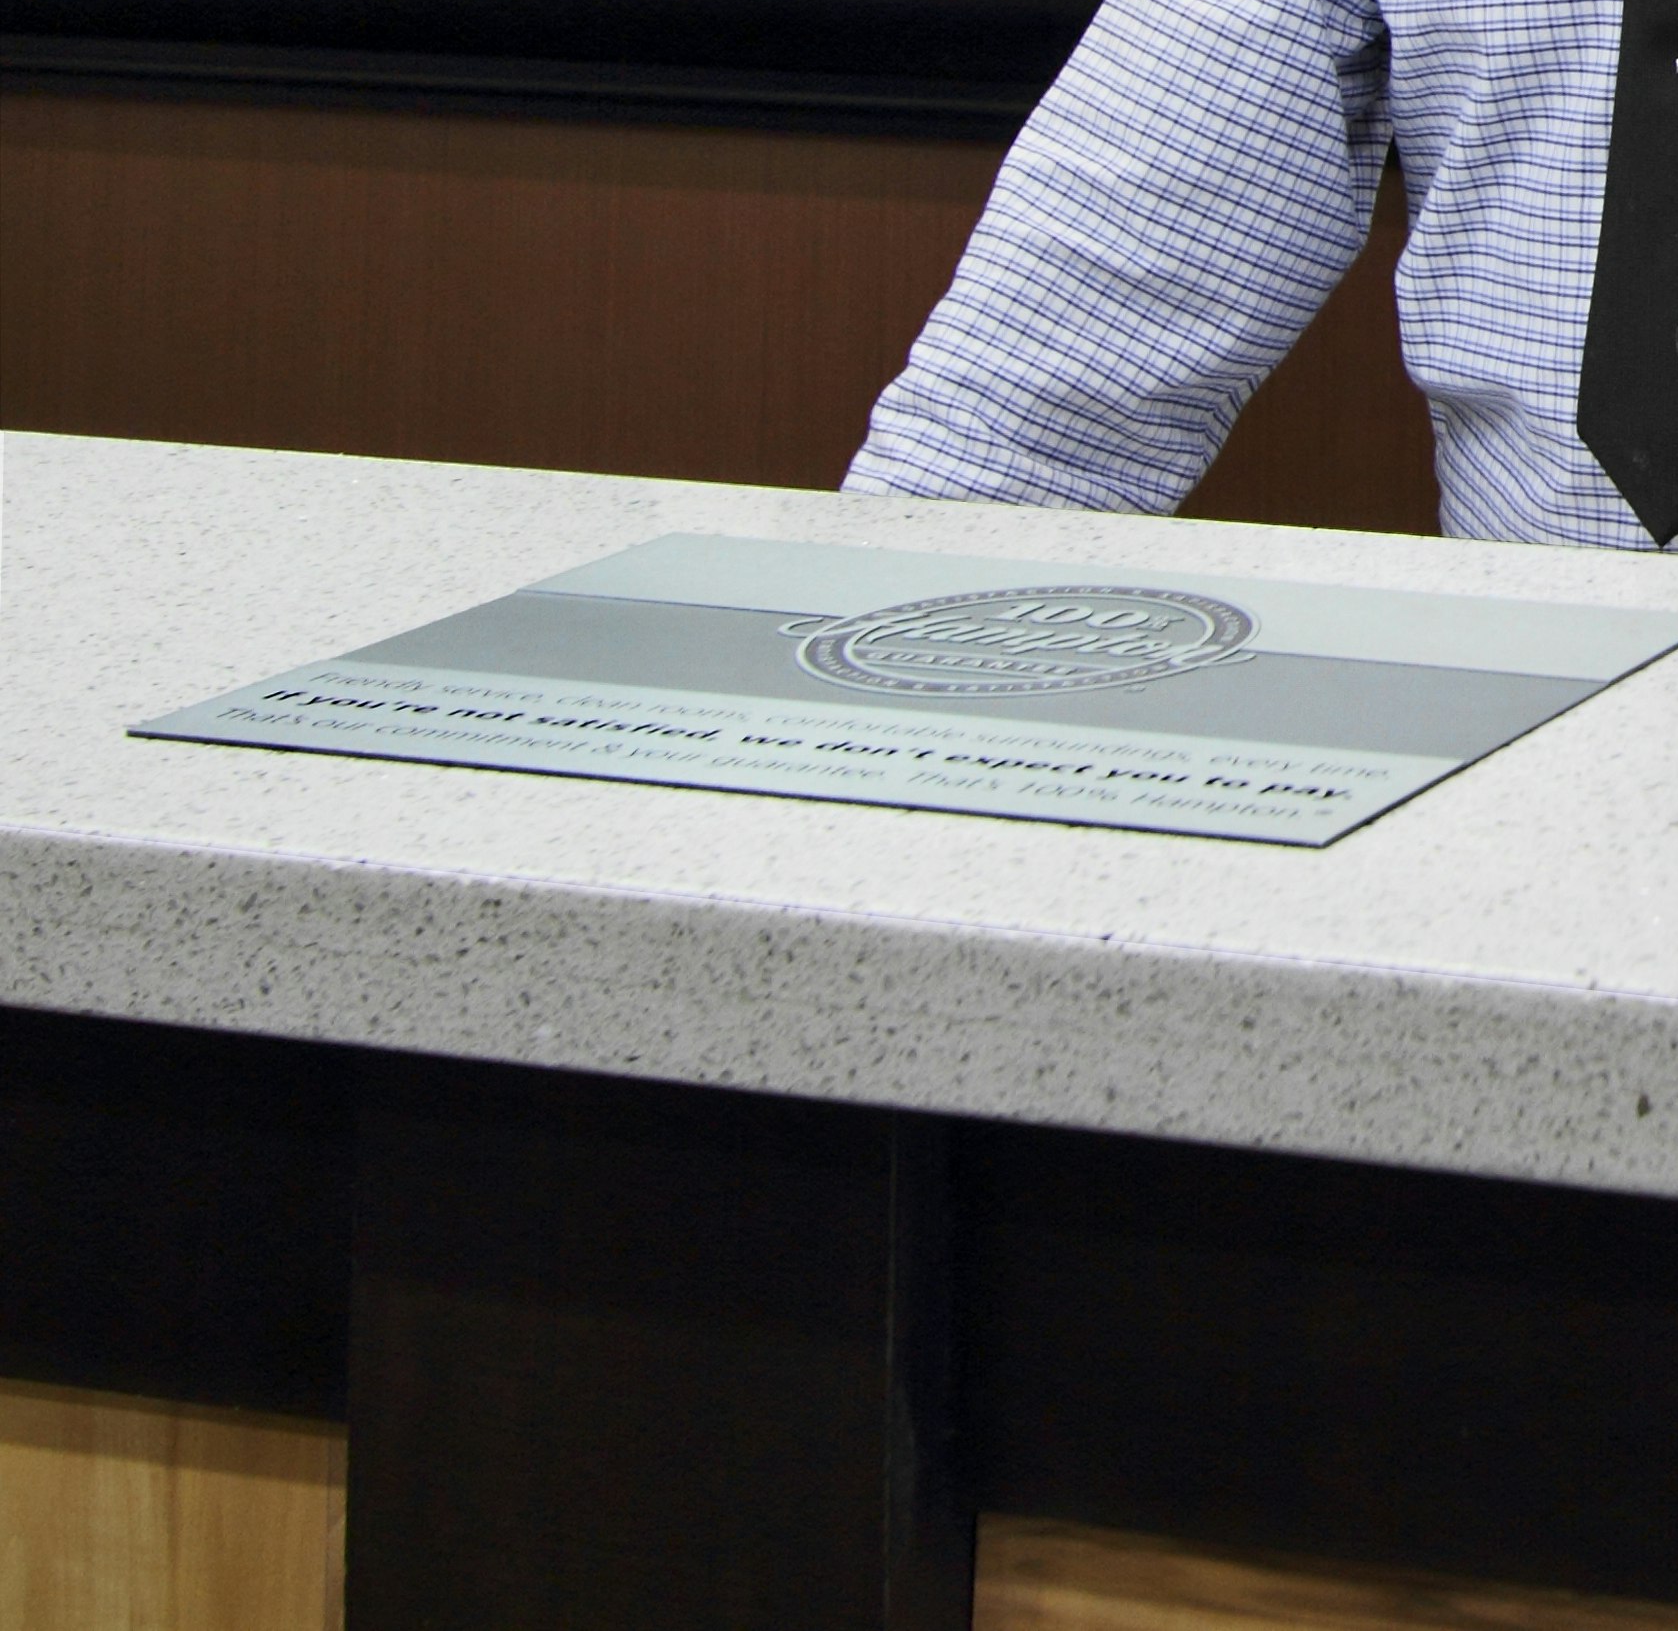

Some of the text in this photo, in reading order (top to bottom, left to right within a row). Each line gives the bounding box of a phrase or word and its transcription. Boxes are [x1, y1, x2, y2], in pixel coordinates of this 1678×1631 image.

[779, 610, 1258, 668] Hampton
[986, 601, 1186, 633] 100%
[865, 652, 1080, 676] GUARANTEE
[216, 707, 302, 725] That's
[311, 717, 369, 731] our
[375, 725, 590, 753] commitment
[623, 747, 702, 762] your
[907, 770, 1002, 792] That's
[1016, 780, 1122, 802] 100%
[263, 690, 1354, 801] If you're not satisfied, we don't expect you to pay.
[308, 671, 430, 693] Friendly
[557, 694, 641, 710] clean
[766, 714, 965, 738] comfortable
[1210, 754, 1302, 773] every
